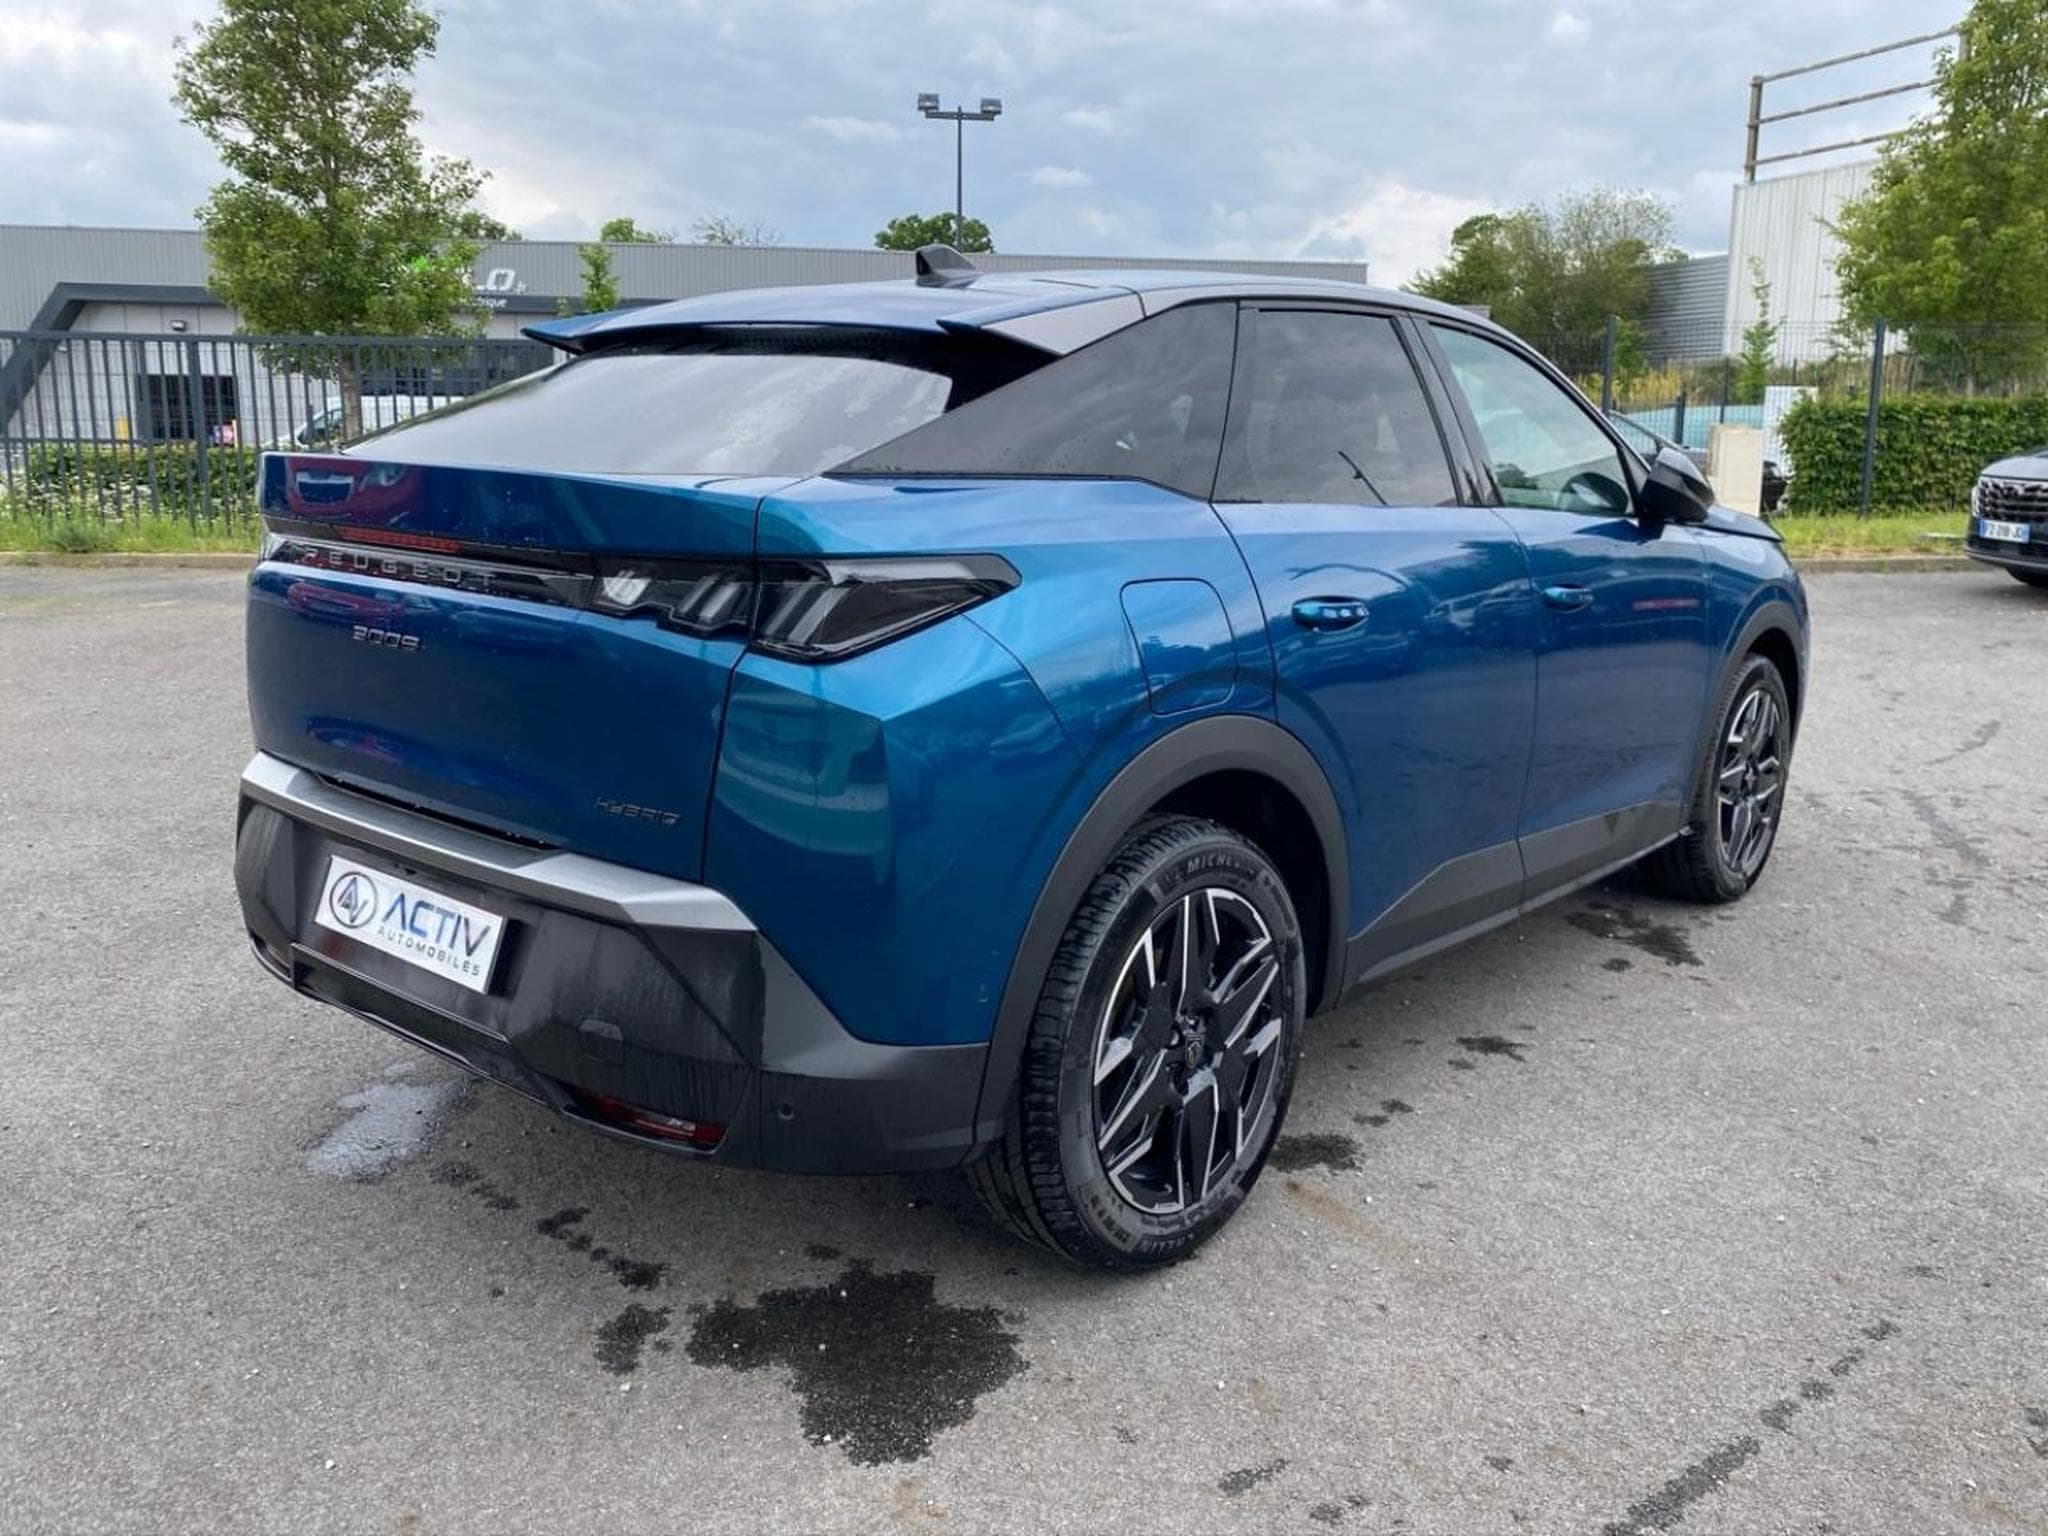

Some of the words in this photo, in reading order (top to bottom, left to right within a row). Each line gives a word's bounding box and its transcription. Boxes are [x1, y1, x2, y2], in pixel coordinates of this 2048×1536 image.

[301, 548, 496, 587] PEUGEOT
[381, 892, 492, 957] ACTIV
[377, 926, 481, 977] AUTOMOBILES
